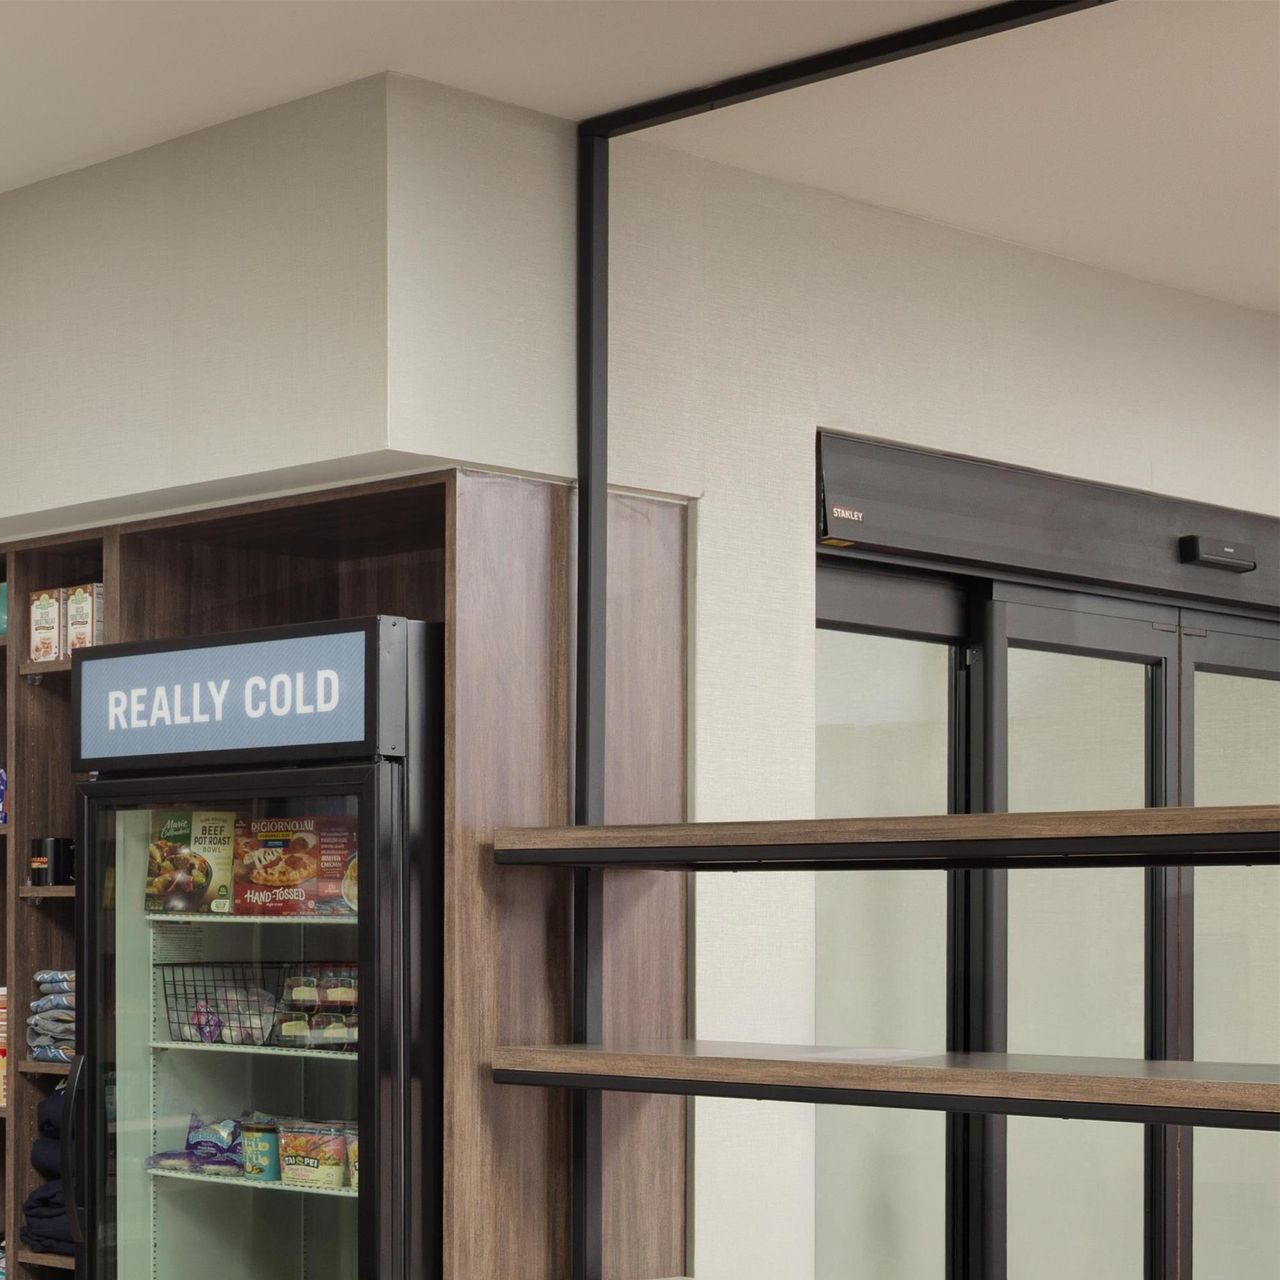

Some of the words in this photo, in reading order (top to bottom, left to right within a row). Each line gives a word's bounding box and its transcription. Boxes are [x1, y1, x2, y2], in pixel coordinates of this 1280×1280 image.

[833, 508, 863, 520] STANLEY
[107, 679, 230, 730] REALLY
[244, 669, 339, 719] COLD
[166, 819, 188, 830] Marie
[201, 825, 225, 836] BEEF
[193, 836, 207, 846] POT
[208, 835, 231, 846] ROAST
[203, 846, 222, 854] BOWL
[244, 888, 306, 904] HAND-TOSSED
[285, 1156, 295, 1166] TAI
[304, 1158, 318, 1168] PEI
